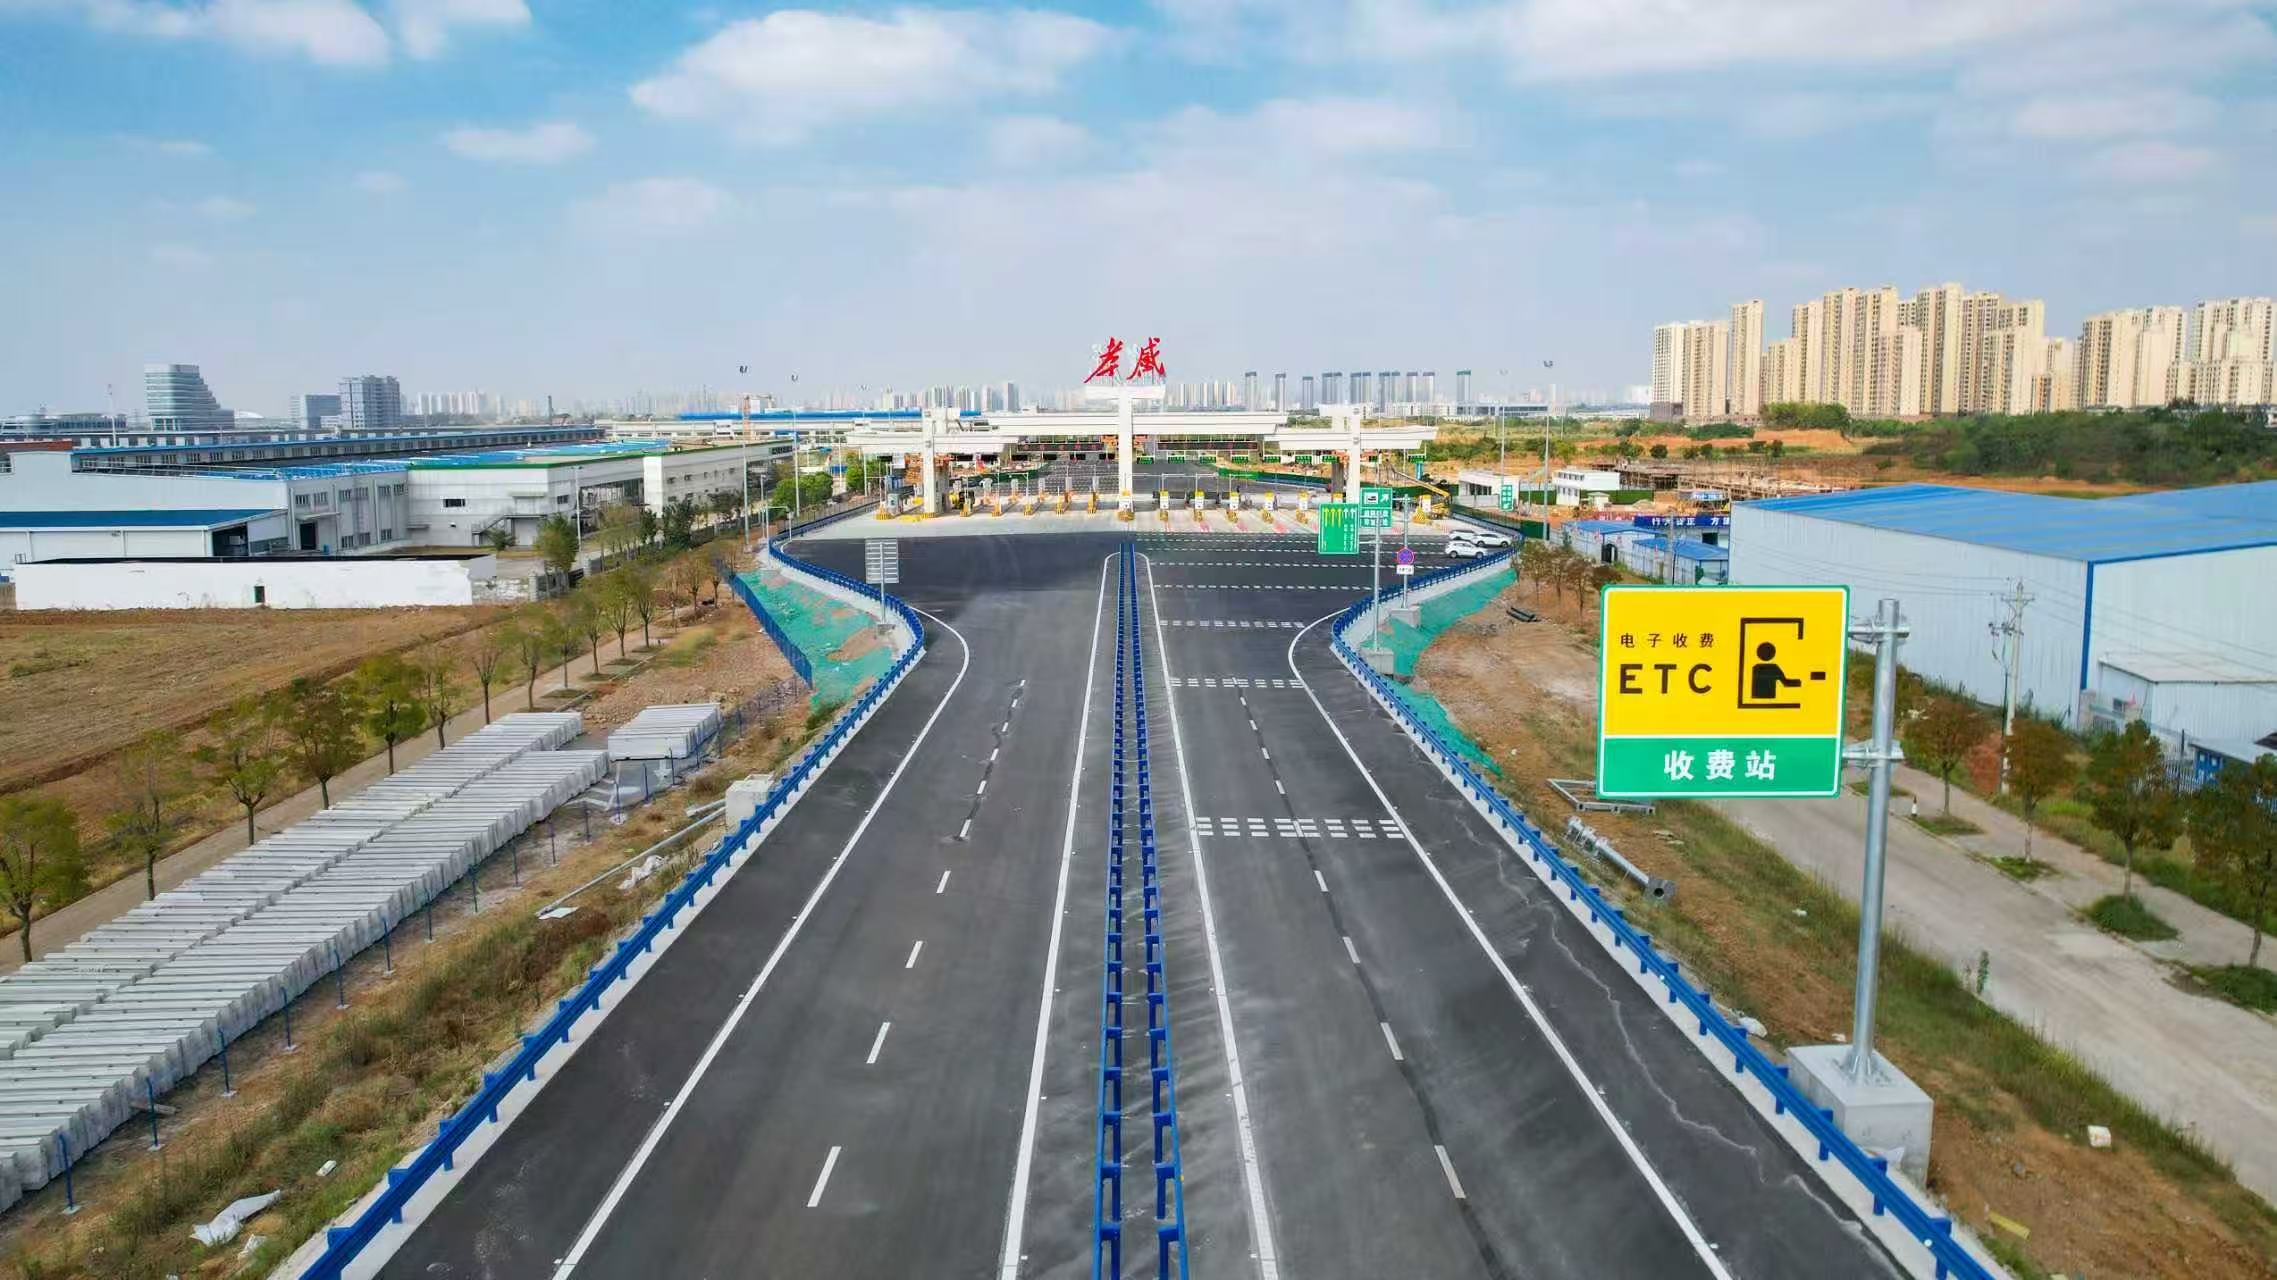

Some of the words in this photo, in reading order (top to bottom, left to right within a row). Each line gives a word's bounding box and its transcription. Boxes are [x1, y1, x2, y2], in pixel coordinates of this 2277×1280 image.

[1620, 633, 1714, 648] 电子收费
[1619, 663, 1713, 695] ETC
[1663, 749, 1777, 781] 收费站
